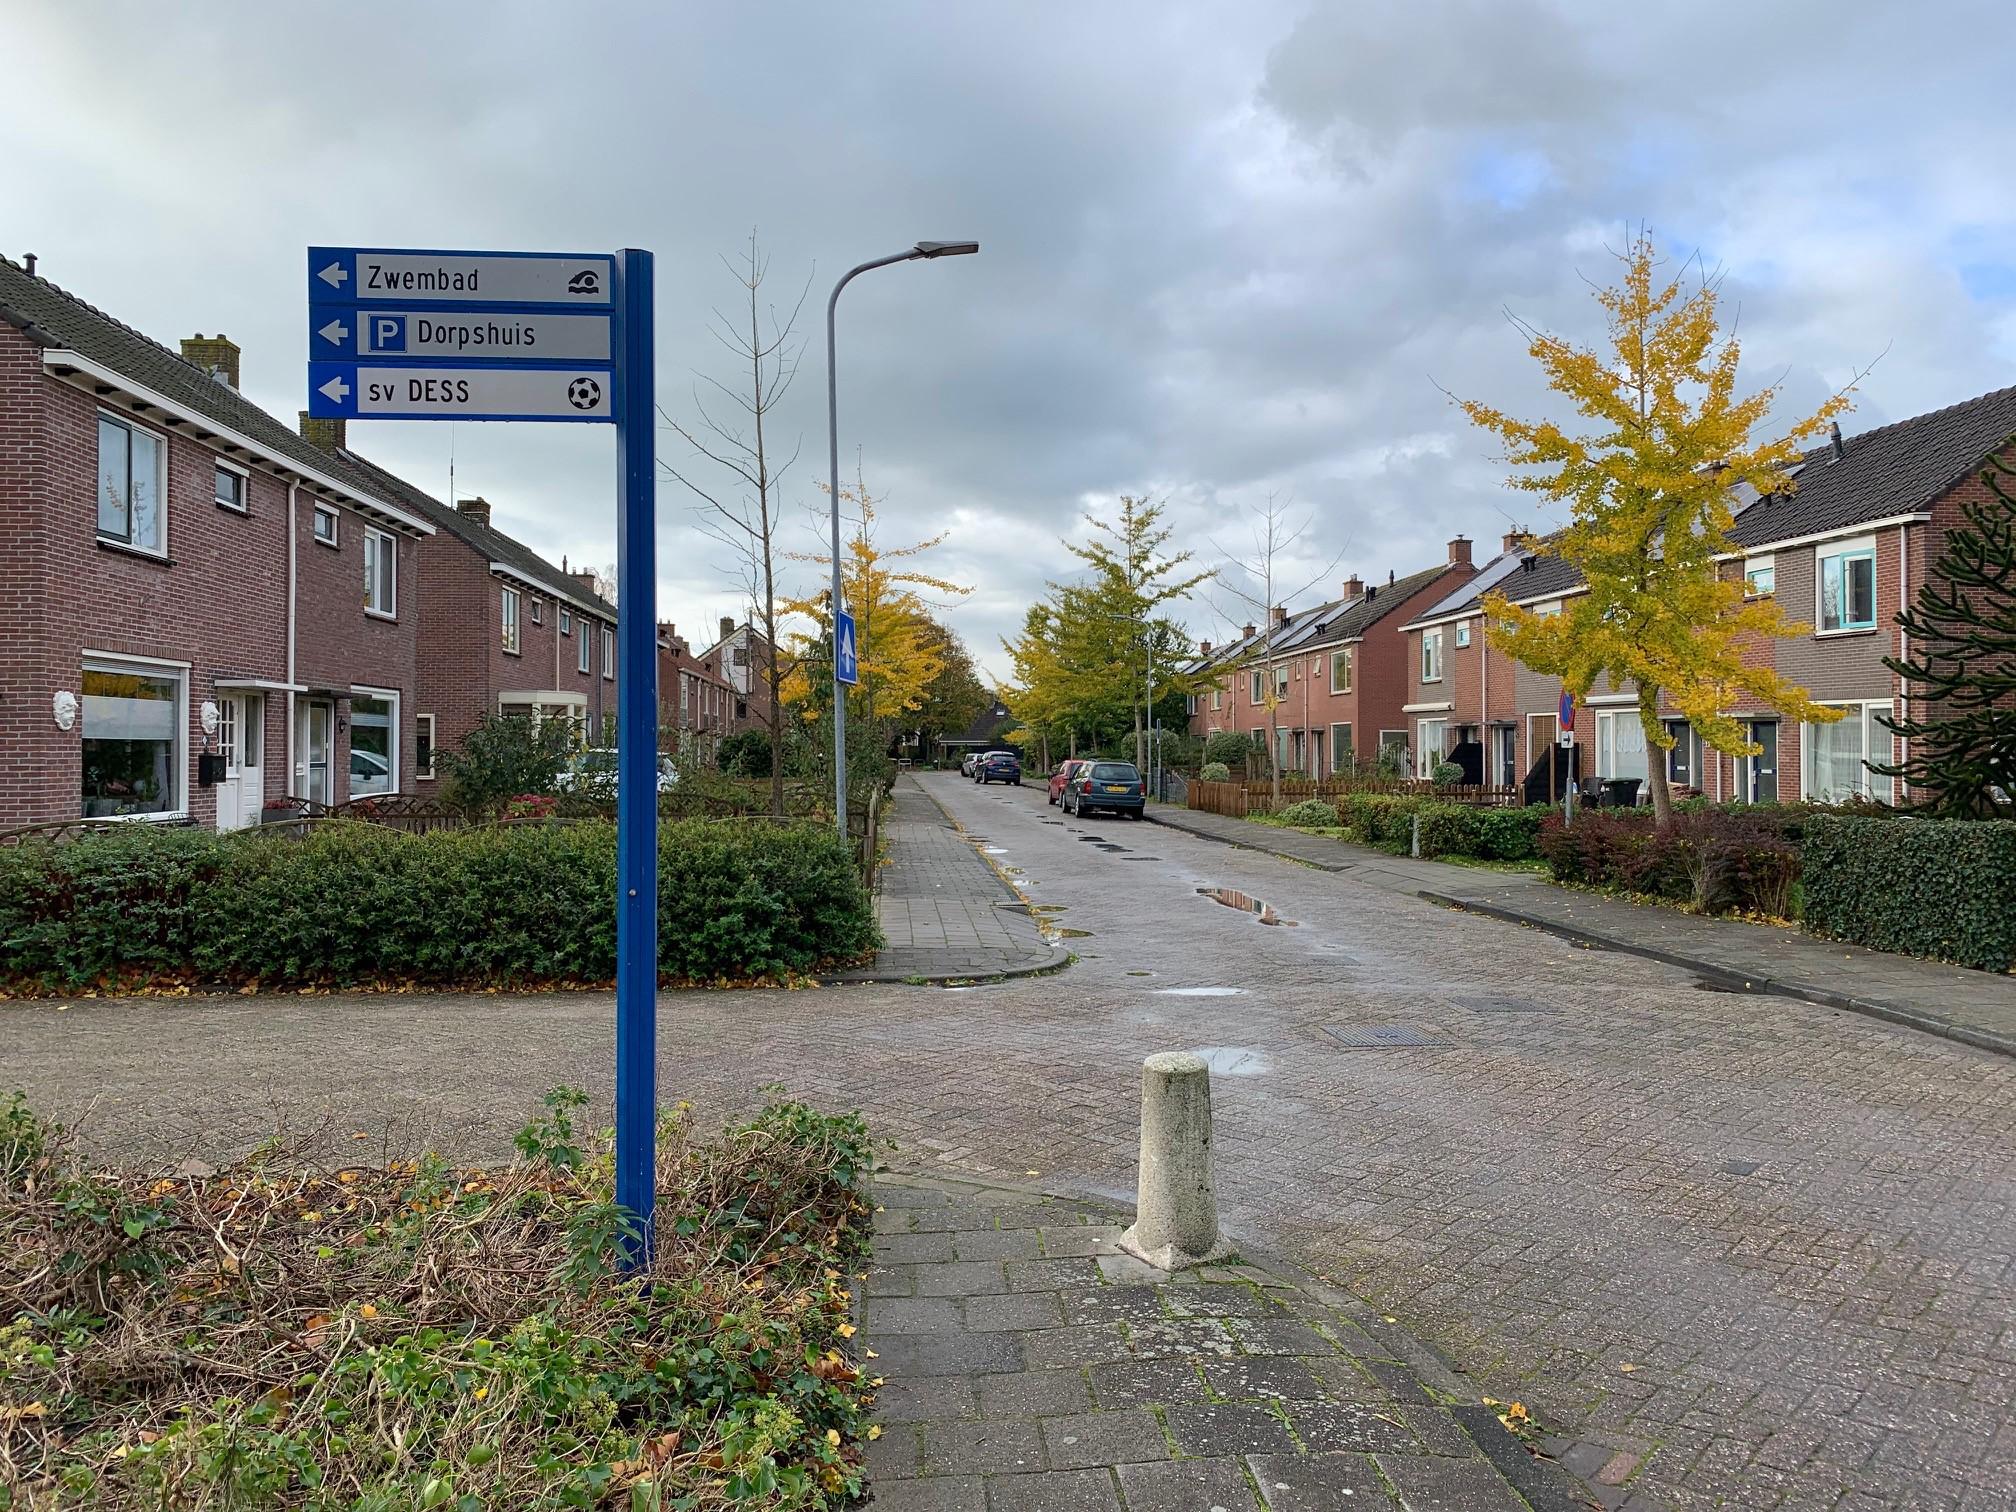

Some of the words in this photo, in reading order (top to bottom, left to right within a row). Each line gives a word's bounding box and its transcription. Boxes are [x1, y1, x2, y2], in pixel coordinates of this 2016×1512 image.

[368, 264, 479, 292] Zwembad
[378, 320, 398, 348] P
[418, 319, 536, 351] Dorpshuis
[368, 383, 395, 402] sv
[408, 379, 470, 404] DESS
